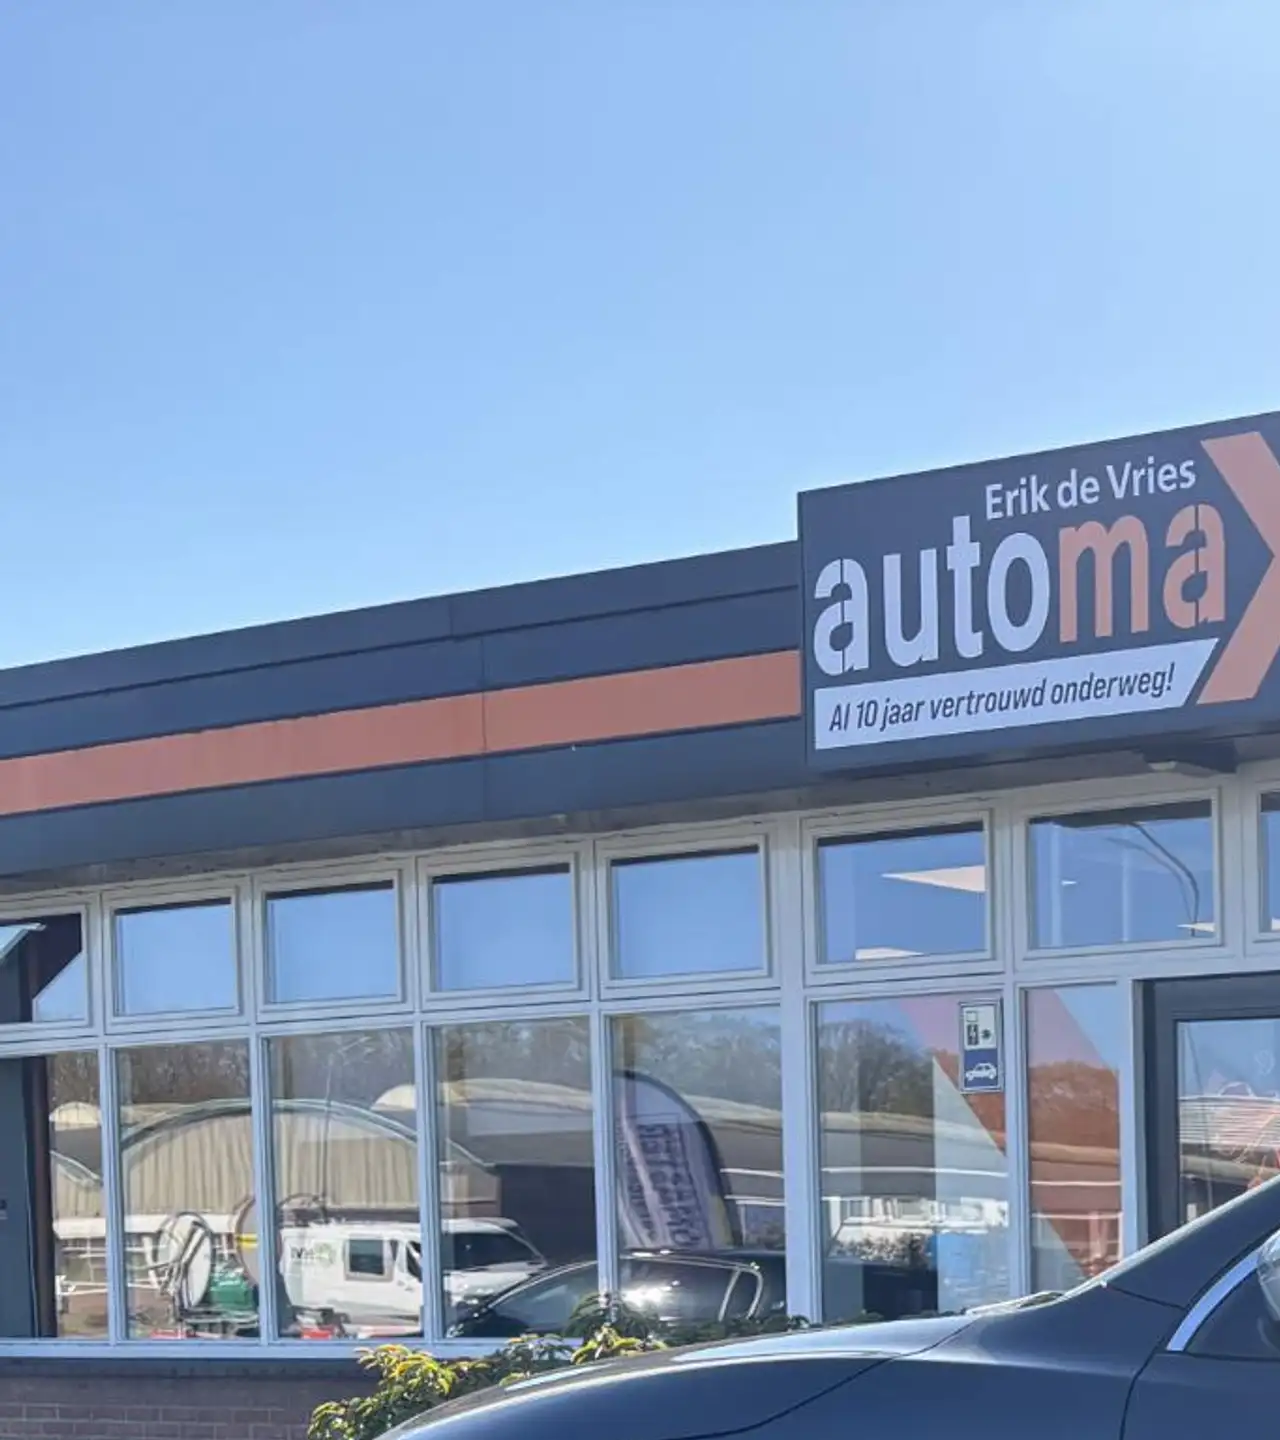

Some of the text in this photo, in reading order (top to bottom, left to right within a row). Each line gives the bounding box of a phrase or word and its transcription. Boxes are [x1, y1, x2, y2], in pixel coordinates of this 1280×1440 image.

[985, 456, 1197, 521] Erik de Vries
[828, 661, 1176, 733] Al 10 jaar vertrouwd onderweg!
